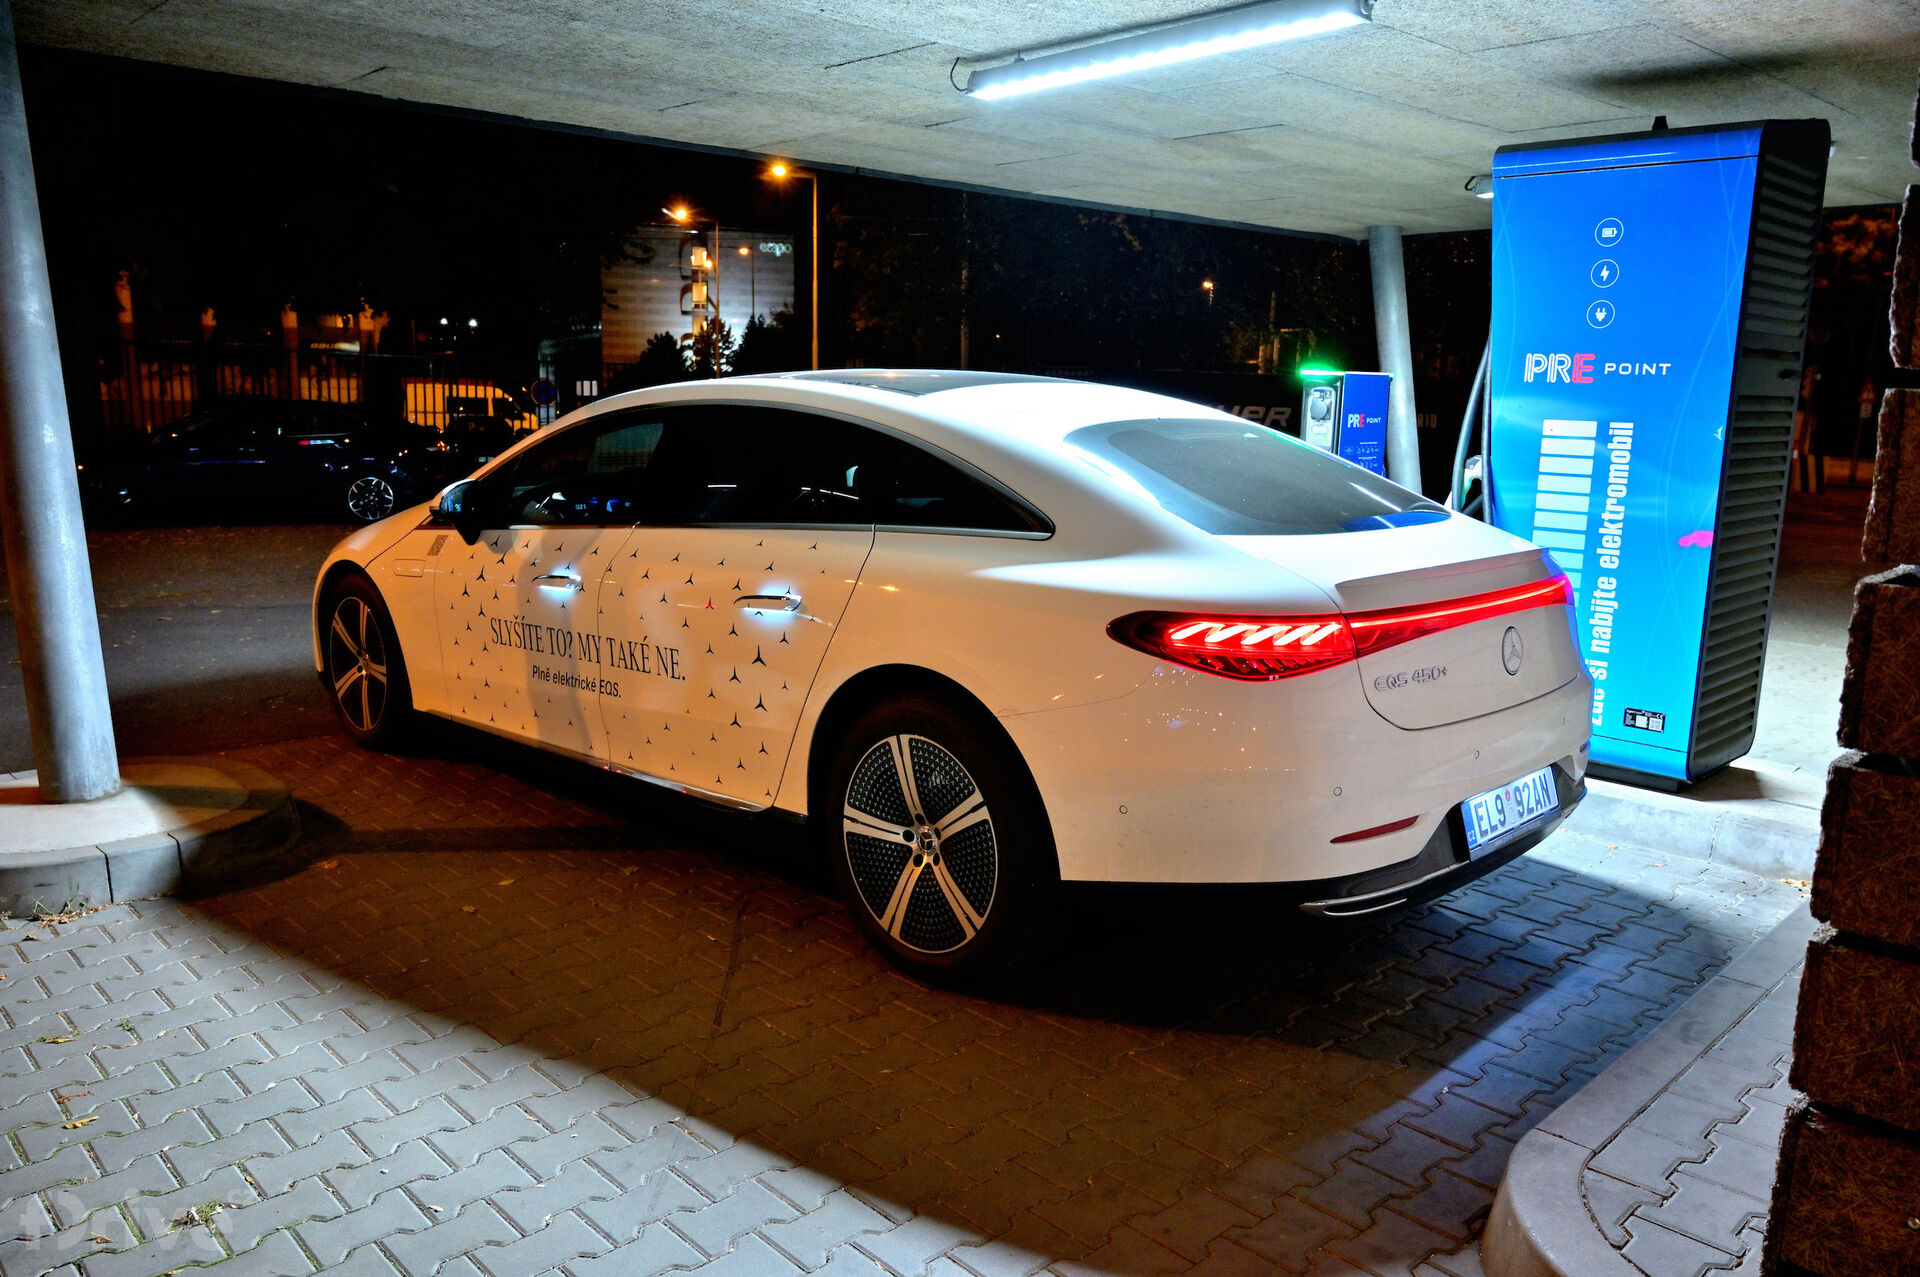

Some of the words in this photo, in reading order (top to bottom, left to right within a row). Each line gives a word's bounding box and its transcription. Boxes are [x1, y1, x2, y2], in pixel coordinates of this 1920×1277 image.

[1524, 353, 1596, 384] PRE
[1604, 363, 1672, 376] POINT
[1347, 413, 1366, 428] PRE
[1597, 421, 1634, 570] elektromobil
[1589, 576, 1618, 655] nabijte
[490, 614, 545, 653] SLYŠÍTE
[546, 626, 573, 659] TO?
[576, 632, 603, 664] MY
[606, 635, 651, 674] TAKÉ
[655, 645, 686, 681] NE.
[532, 664, 551, 682] Plně
[552, 669, 597, 693] elektrické
[599, 679, 622, 699] EQS.
[1374, 672, 1409, 692] EQS
[1585, 659, 1608, 681] si
[1474, 794, 1505, 838] EL9
[1514, 773, 1551, 817] 92AN
